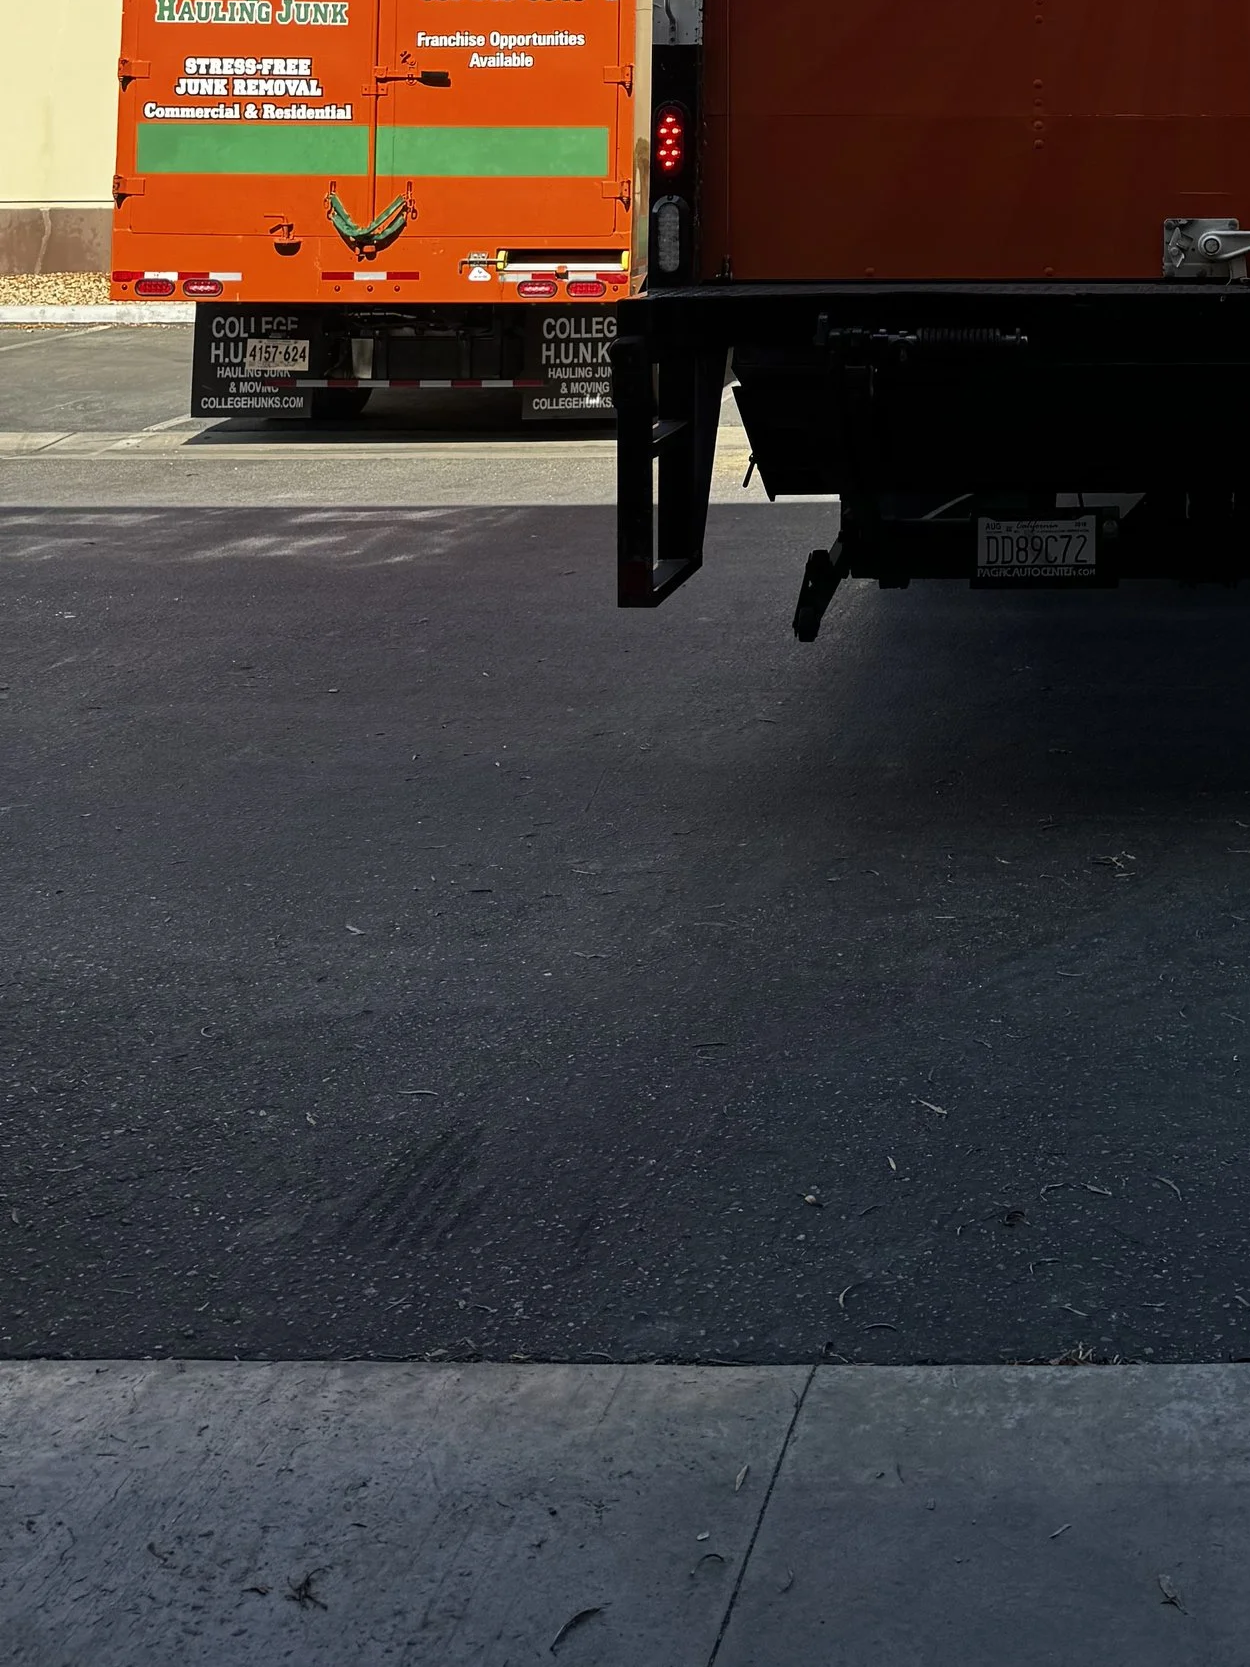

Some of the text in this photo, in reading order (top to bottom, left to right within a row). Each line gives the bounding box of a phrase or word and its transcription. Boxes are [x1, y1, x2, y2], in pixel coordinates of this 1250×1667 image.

[417, 31, 586, 49] Franchise Opportunities
[185, 57, 311, 75] STRESS-FREE
[469, 52, 534, 68] Available
[176, 78, 322, 96] JUNK REMOVAL
[144, 103, 352, 120] Commercial & Residential
[543, 316, 617, 339] COLLEG
[542, 342, 612, 364] H.U.N.K
[548, 367, 593, 378] HAULING
[229, 381, 237, 393] &
[560, 381, 610, 393] & MOVING
[201, 397, 303, 409] COLLEGEHUNKS.COM
[986, 535, 1087, 564] DD89C72
